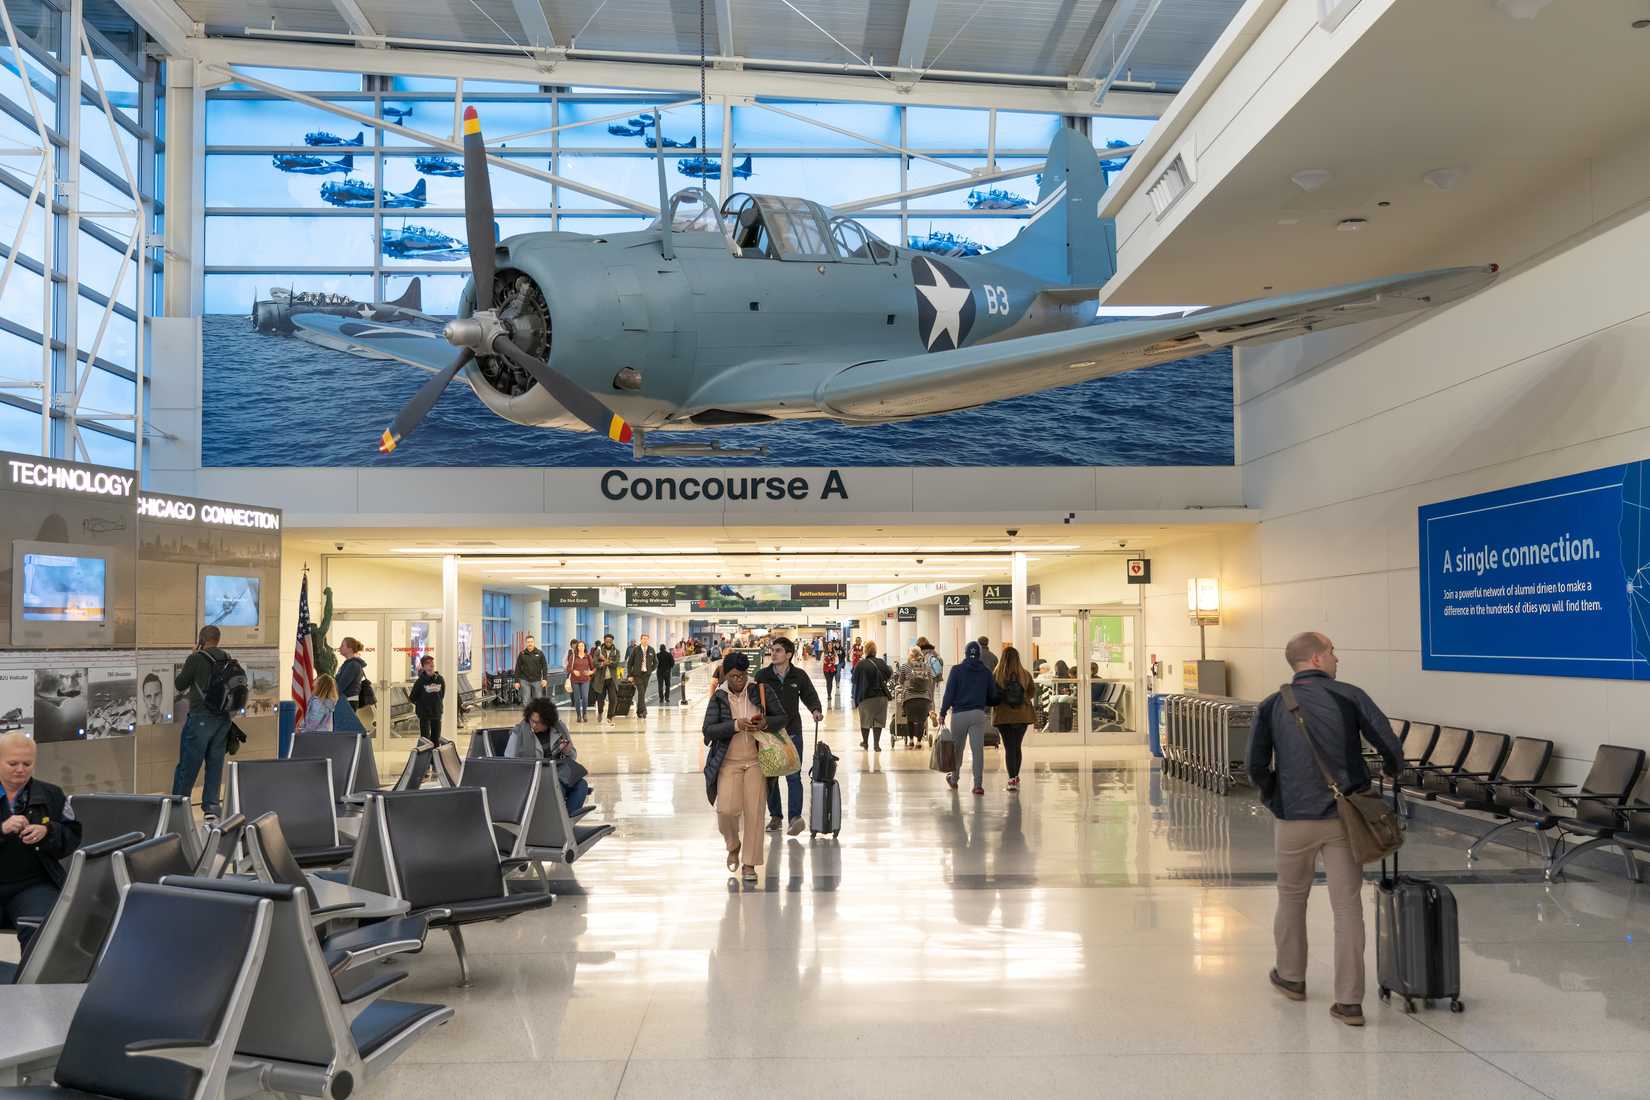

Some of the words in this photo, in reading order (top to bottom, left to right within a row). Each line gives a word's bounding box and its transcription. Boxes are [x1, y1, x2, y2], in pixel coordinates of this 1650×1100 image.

[984, 285, 1010, 316] B3
[9, 460, 134, 496] TECHNOLOGY
[601, 469, 809, 500] Concourse
[820, 469, 849, 499] A
[201, 505, 279, 530] CONNECTION
[1443, 550, 1452, 573] A
[1456, 546, 1498, 576] single
[1502, 533, 1601, 567] connection.
[945, 596, 960, 605] A2
[985, 586, 1000, 597] A1
[1443, 590, 1454, 599] Join
[1459, 587, 1482, 600] powerful
[1483, 584, 1505, 597] network
[1506, 585, 1513, 596] of
[1514, 583, 1536, 595] alumni
[1536, 582, 1557, 593] driven
[1558, 582, 1566, 592] to
[1567, 580, 1586, 592] make
[1587, 582, 1592, 591] a
[1443, 605, 1469, 616] difference
[1470, 606, 1476, 614] in
[1476, 604, 1485, 614] the
[1486, 603, 1514, 614] hundreds
[1515, 602, 1521, 613] of
[1522, 602, 1538, 613] cities
[1539, 603, 1551, 615] you
[1552, 600, 1565, 612] will
[1566, 600, 1579, 612] find
[1581, 600, 1603, 611] them.
